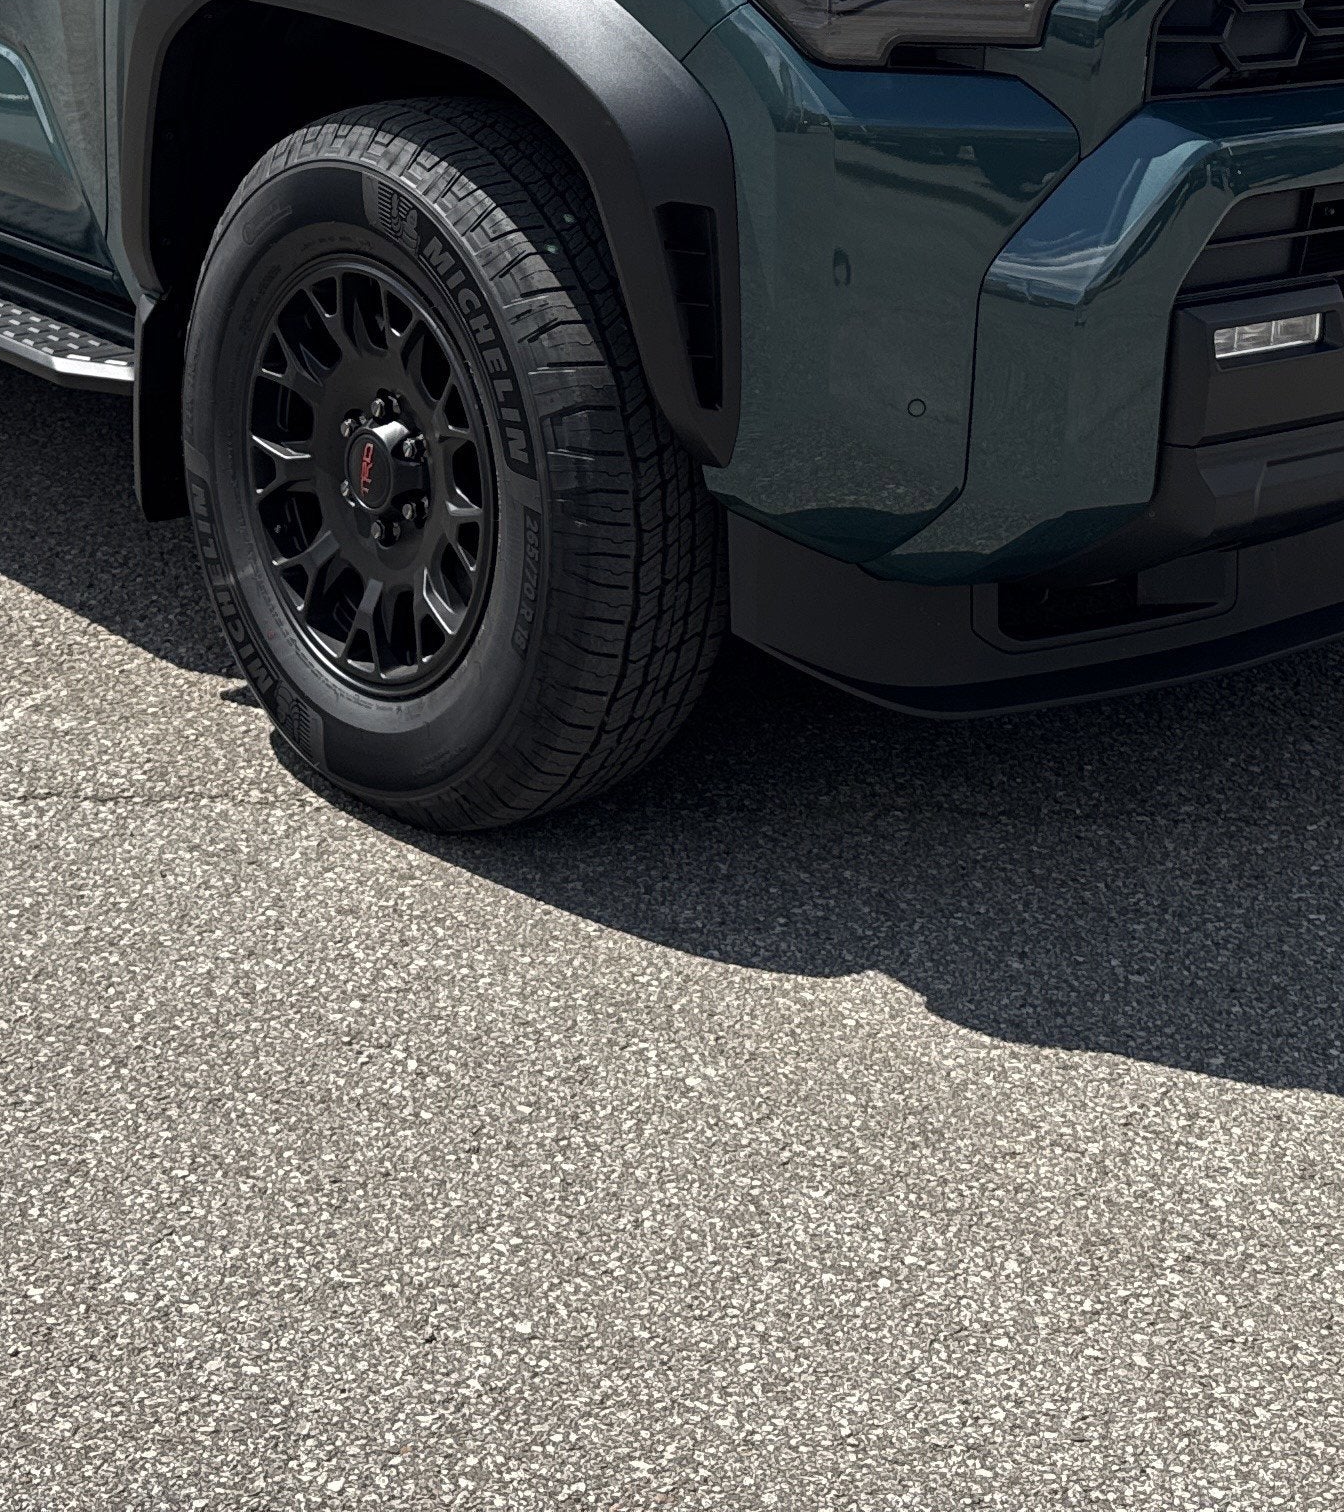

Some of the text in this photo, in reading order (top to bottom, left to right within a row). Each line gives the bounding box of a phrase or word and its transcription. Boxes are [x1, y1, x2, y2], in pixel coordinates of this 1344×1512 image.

[422, 235, 530, 465] MICHELIN
[359, 442, 375, 496] TRD
[191, 480, 277, 694] MICHELIN
